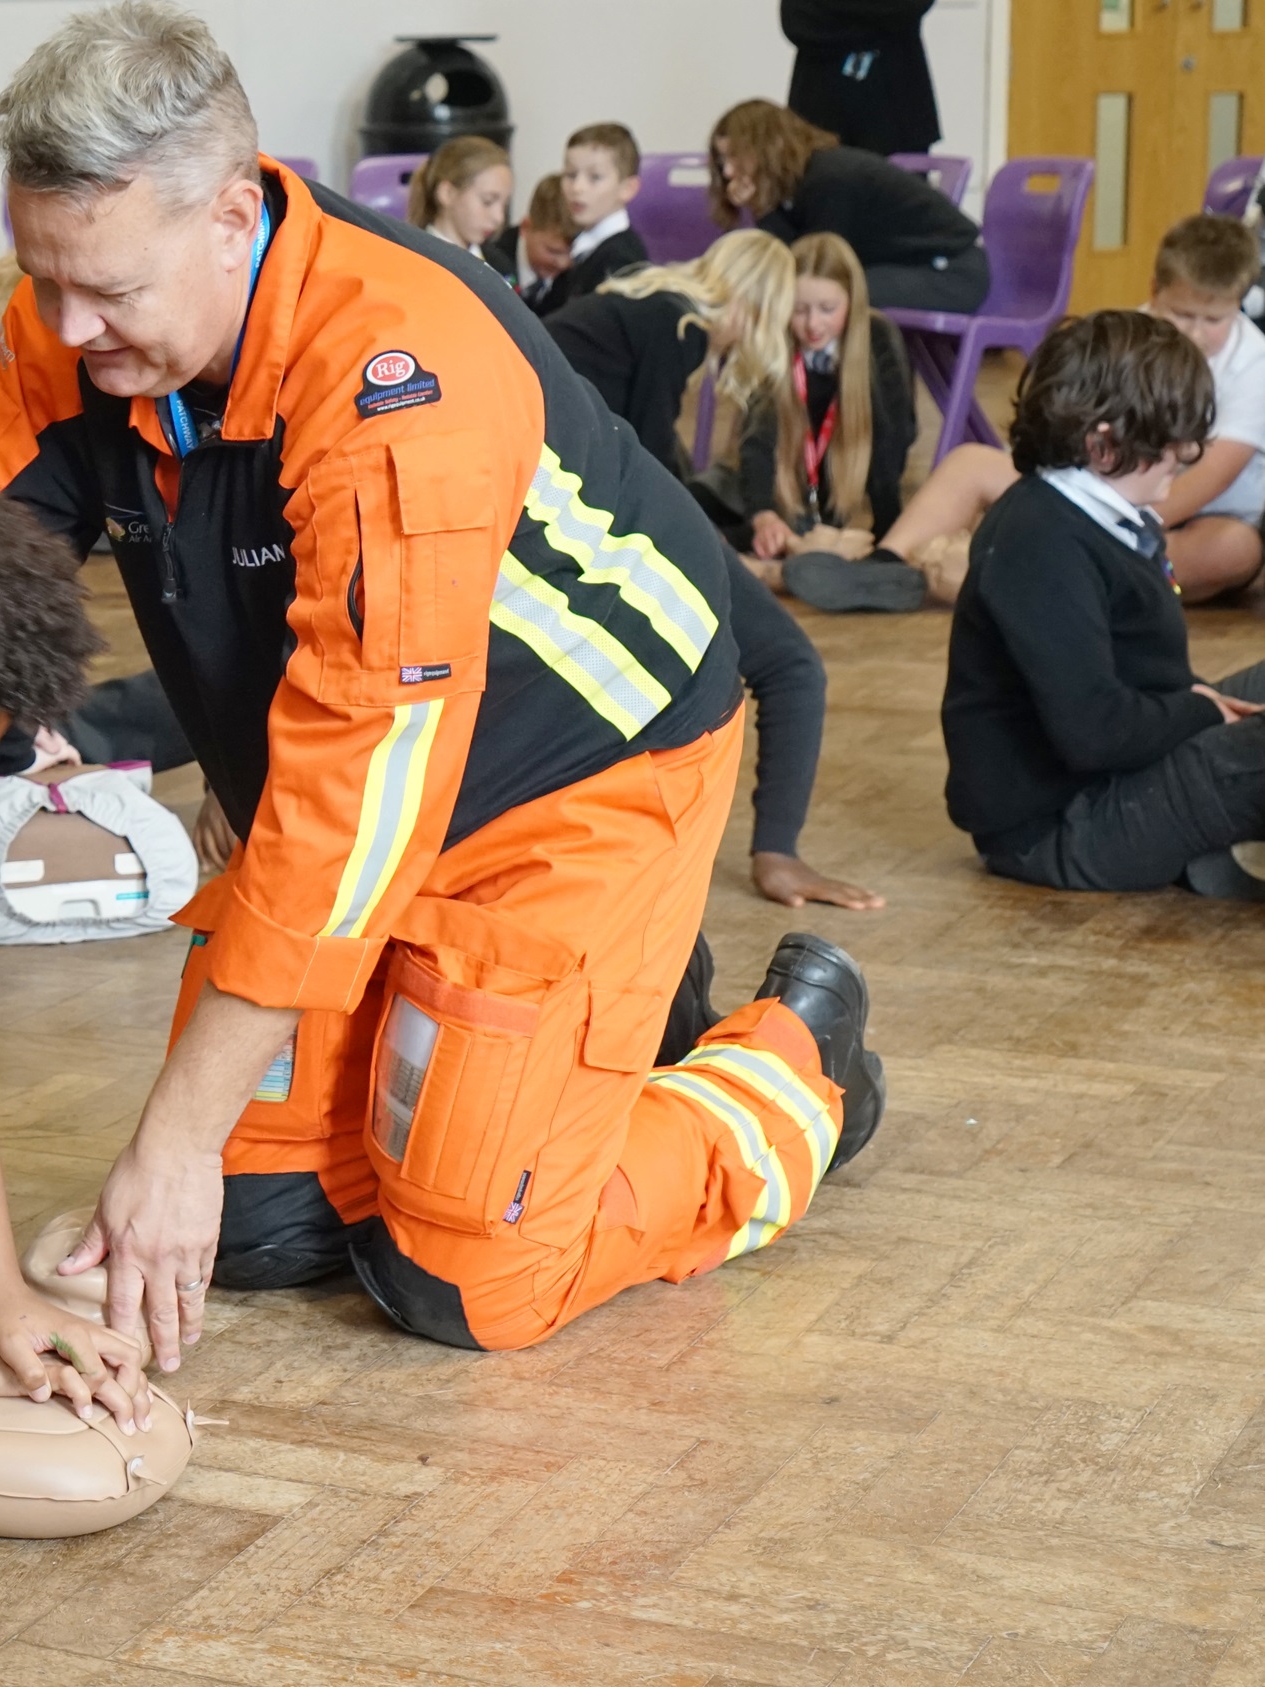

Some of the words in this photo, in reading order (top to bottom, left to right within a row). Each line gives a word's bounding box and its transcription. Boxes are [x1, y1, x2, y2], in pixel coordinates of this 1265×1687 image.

[376, 360, 406, 378] Rig
[360, 385, 405, 406] equipment
[407, 379, 435, 392] limited
[176, 400, 195, 449] PATCHWAY
[232, 543, 286, 567] JULIAN
